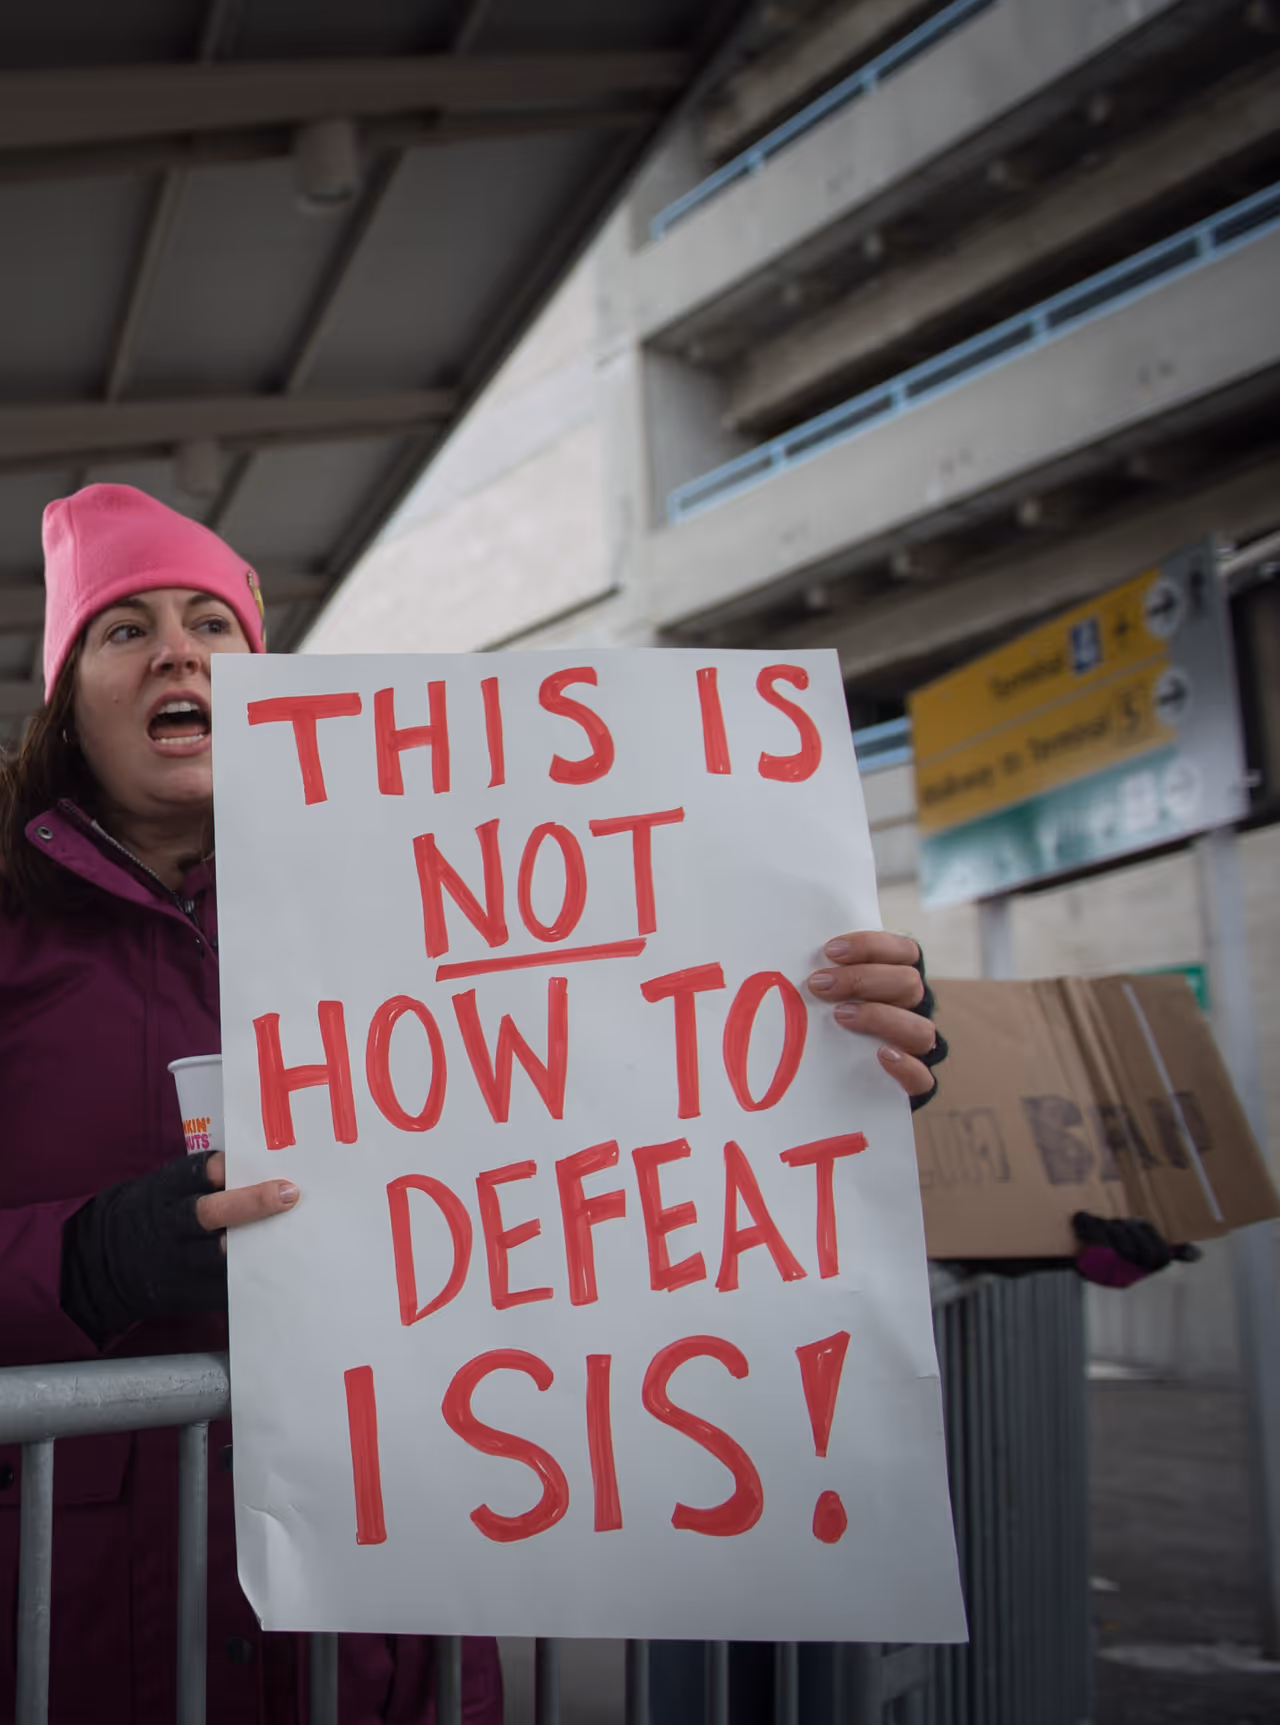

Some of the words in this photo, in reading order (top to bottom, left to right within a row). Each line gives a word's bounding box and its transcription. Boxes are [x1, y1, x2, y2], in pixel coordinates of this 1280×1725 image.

[246, 666, 616, 806] THIS
[695, 663, 823, 783] IS
[412, 806, 686, 960] NOT
[253, 976, 569, 1151] HOW
[640, 962, 809, 1120] TO
[386, 1132, 869, 1327] DEFEAT
